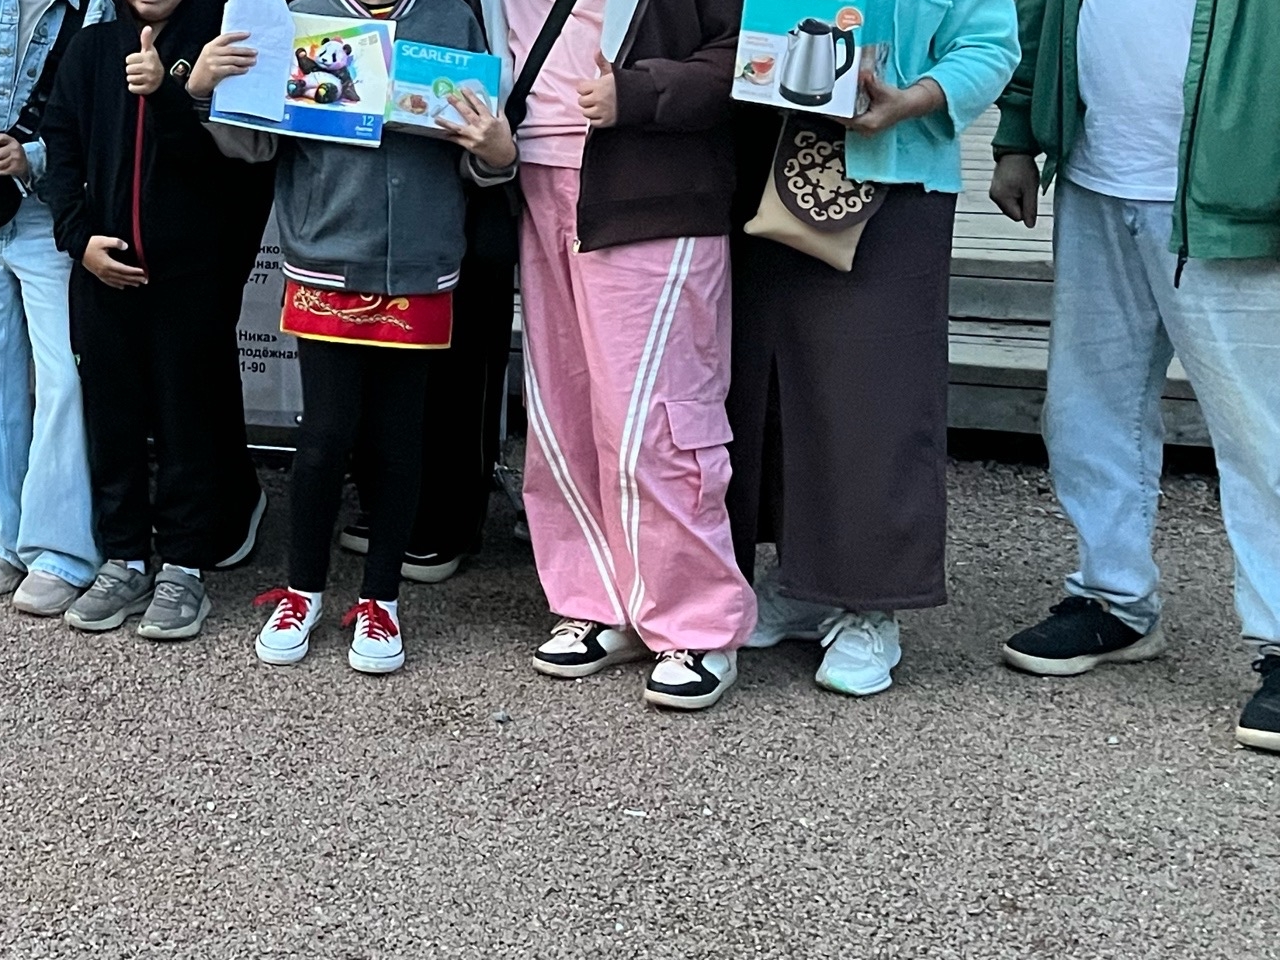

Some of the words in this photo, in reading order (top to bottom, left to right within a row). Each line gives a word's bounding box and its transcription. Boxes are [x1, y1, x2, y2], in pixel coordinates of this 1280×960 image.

[401, 44, 472, 67] SCARLETT
[362, 115, 375, 127] 12
[247, 273, 268, 284] -77
